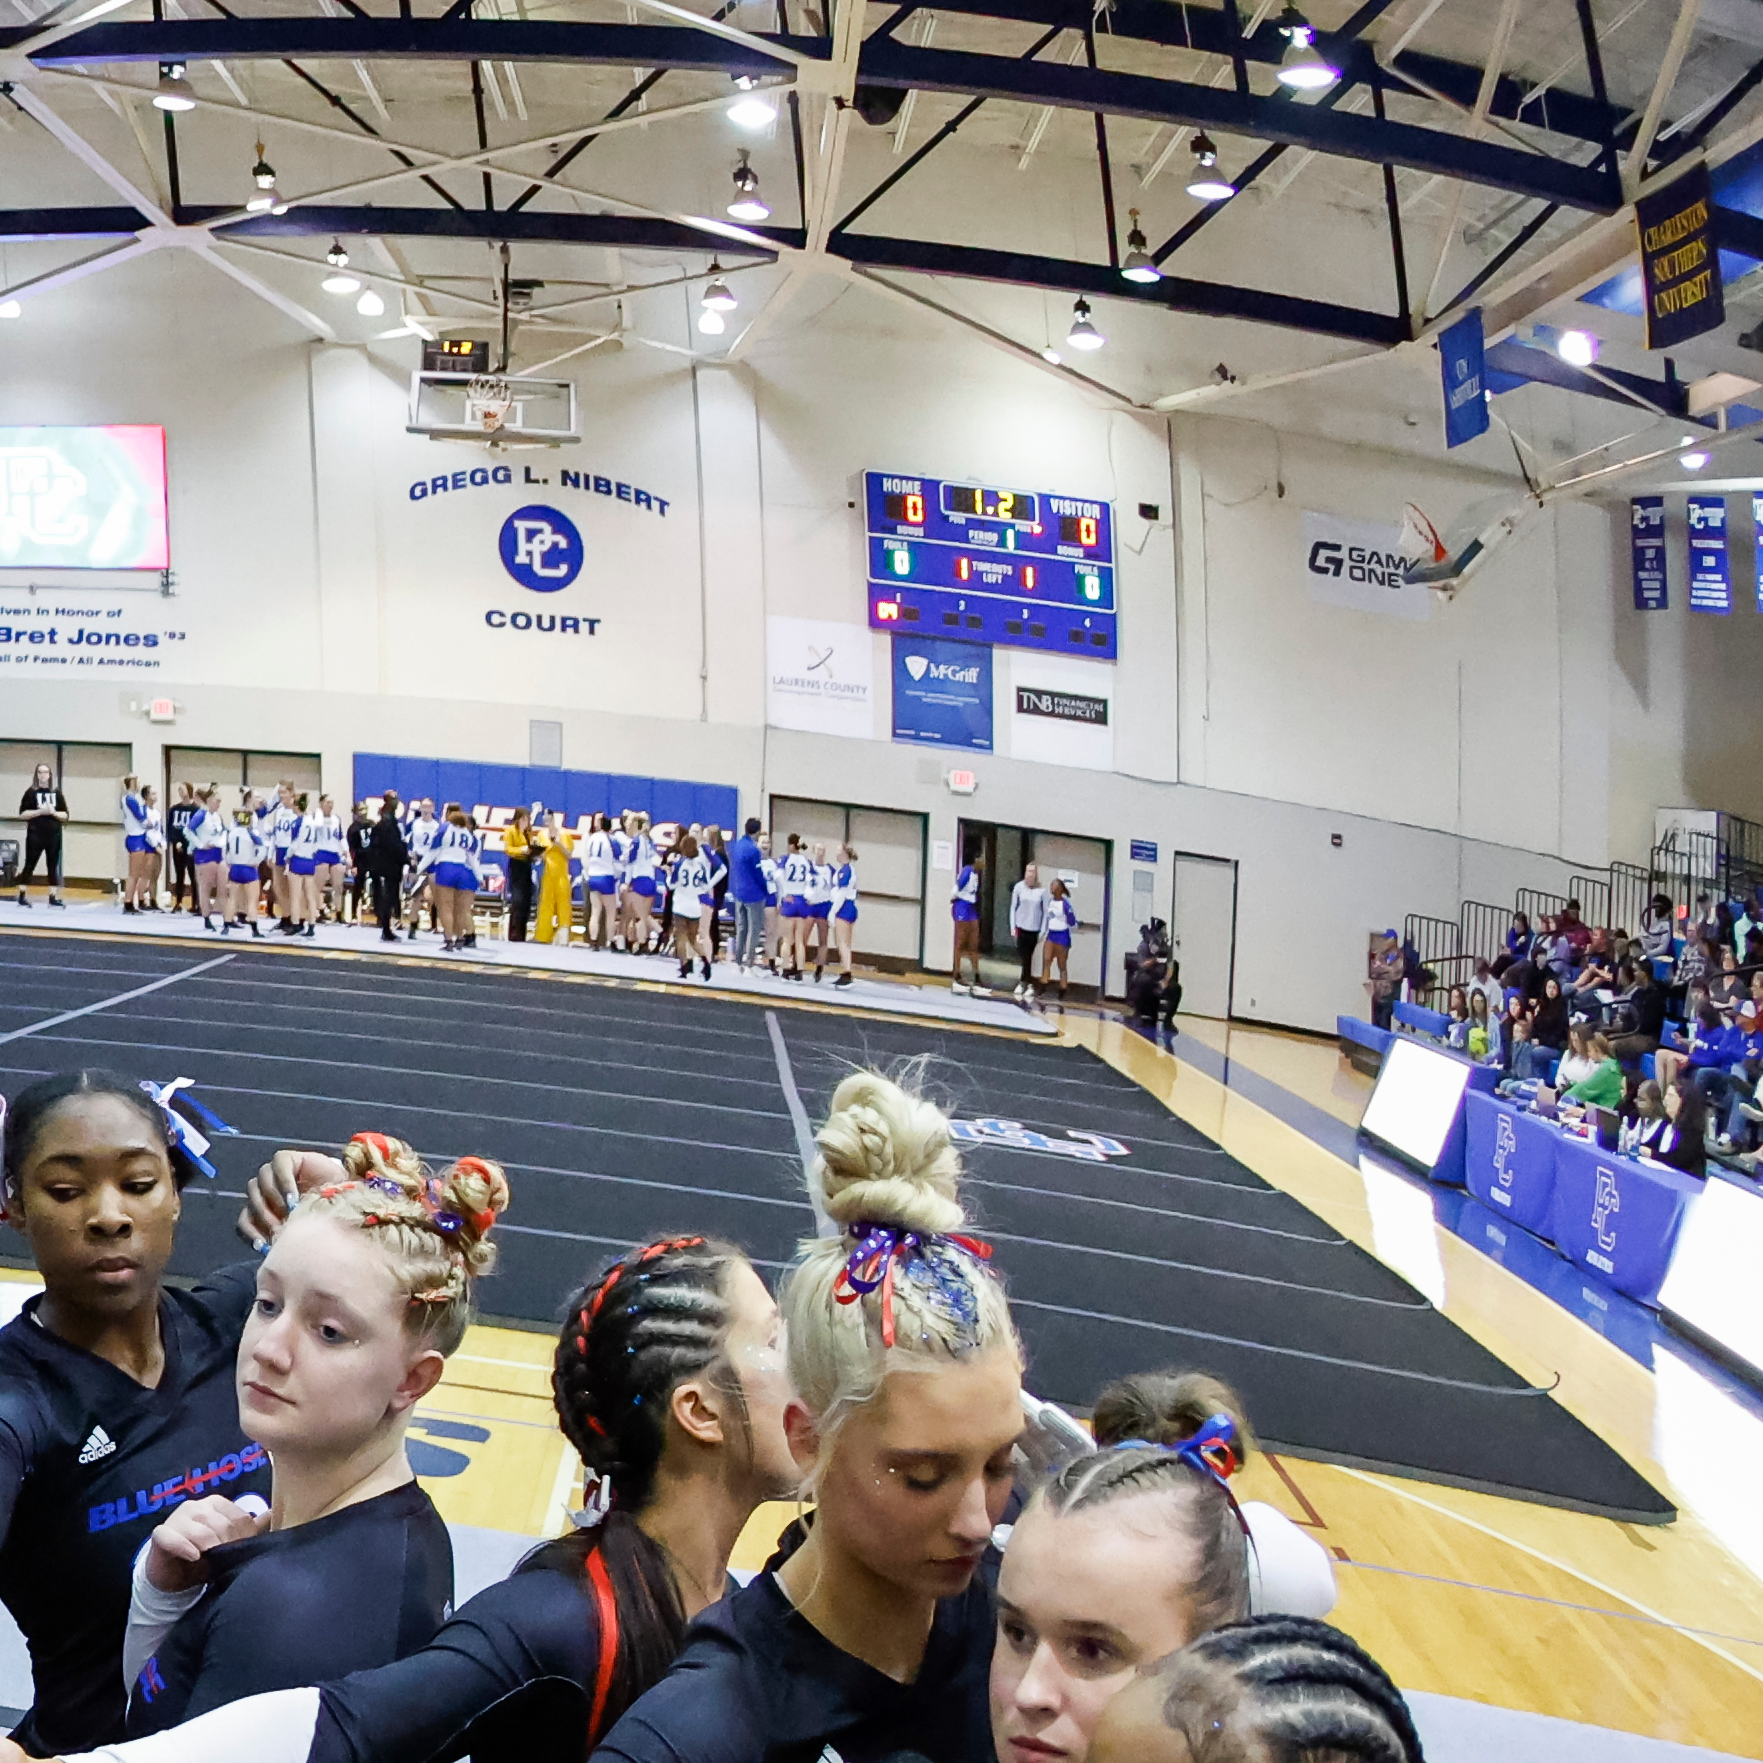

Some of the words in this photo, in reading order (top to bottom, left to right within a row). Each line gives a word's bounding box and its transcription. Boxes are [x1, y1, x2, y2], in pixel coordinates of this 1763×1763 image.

[442, 340, 473, 355] 1.2
[409, 465, 512, 501] GREGG
[523, 466, 550, 485] L.
[560, 469, 671, 518] NIBERT
[882, 477, 922, 495] HOME
[974, 488, 1015, 519] 1.2
[1050, 497, 1101, 519] VISITOR
[513, 519, 569, 578] PC
[1348, 546, 1413, 572] GAM
[1348, 565, 1402, 589] ONE
[36, 606, 50, 617] In
[55, 606, 103, 618] Honor
[107, 607, 123, 619] of
[484, 609, 602, 637] COURT
[67, 628, 160, 648] Jones
[929, 662, 980, 684] McGriff
[772, 676, 822, 692] LAURENS
[824, 680, 869, 696] COUNTY
[1018, 690, 1053, 714] TNB
[787, 863, 806, 882] 23
[77, 1440, 117, 1464] adidas
[88, 1474, 187, 1534] BLUE
